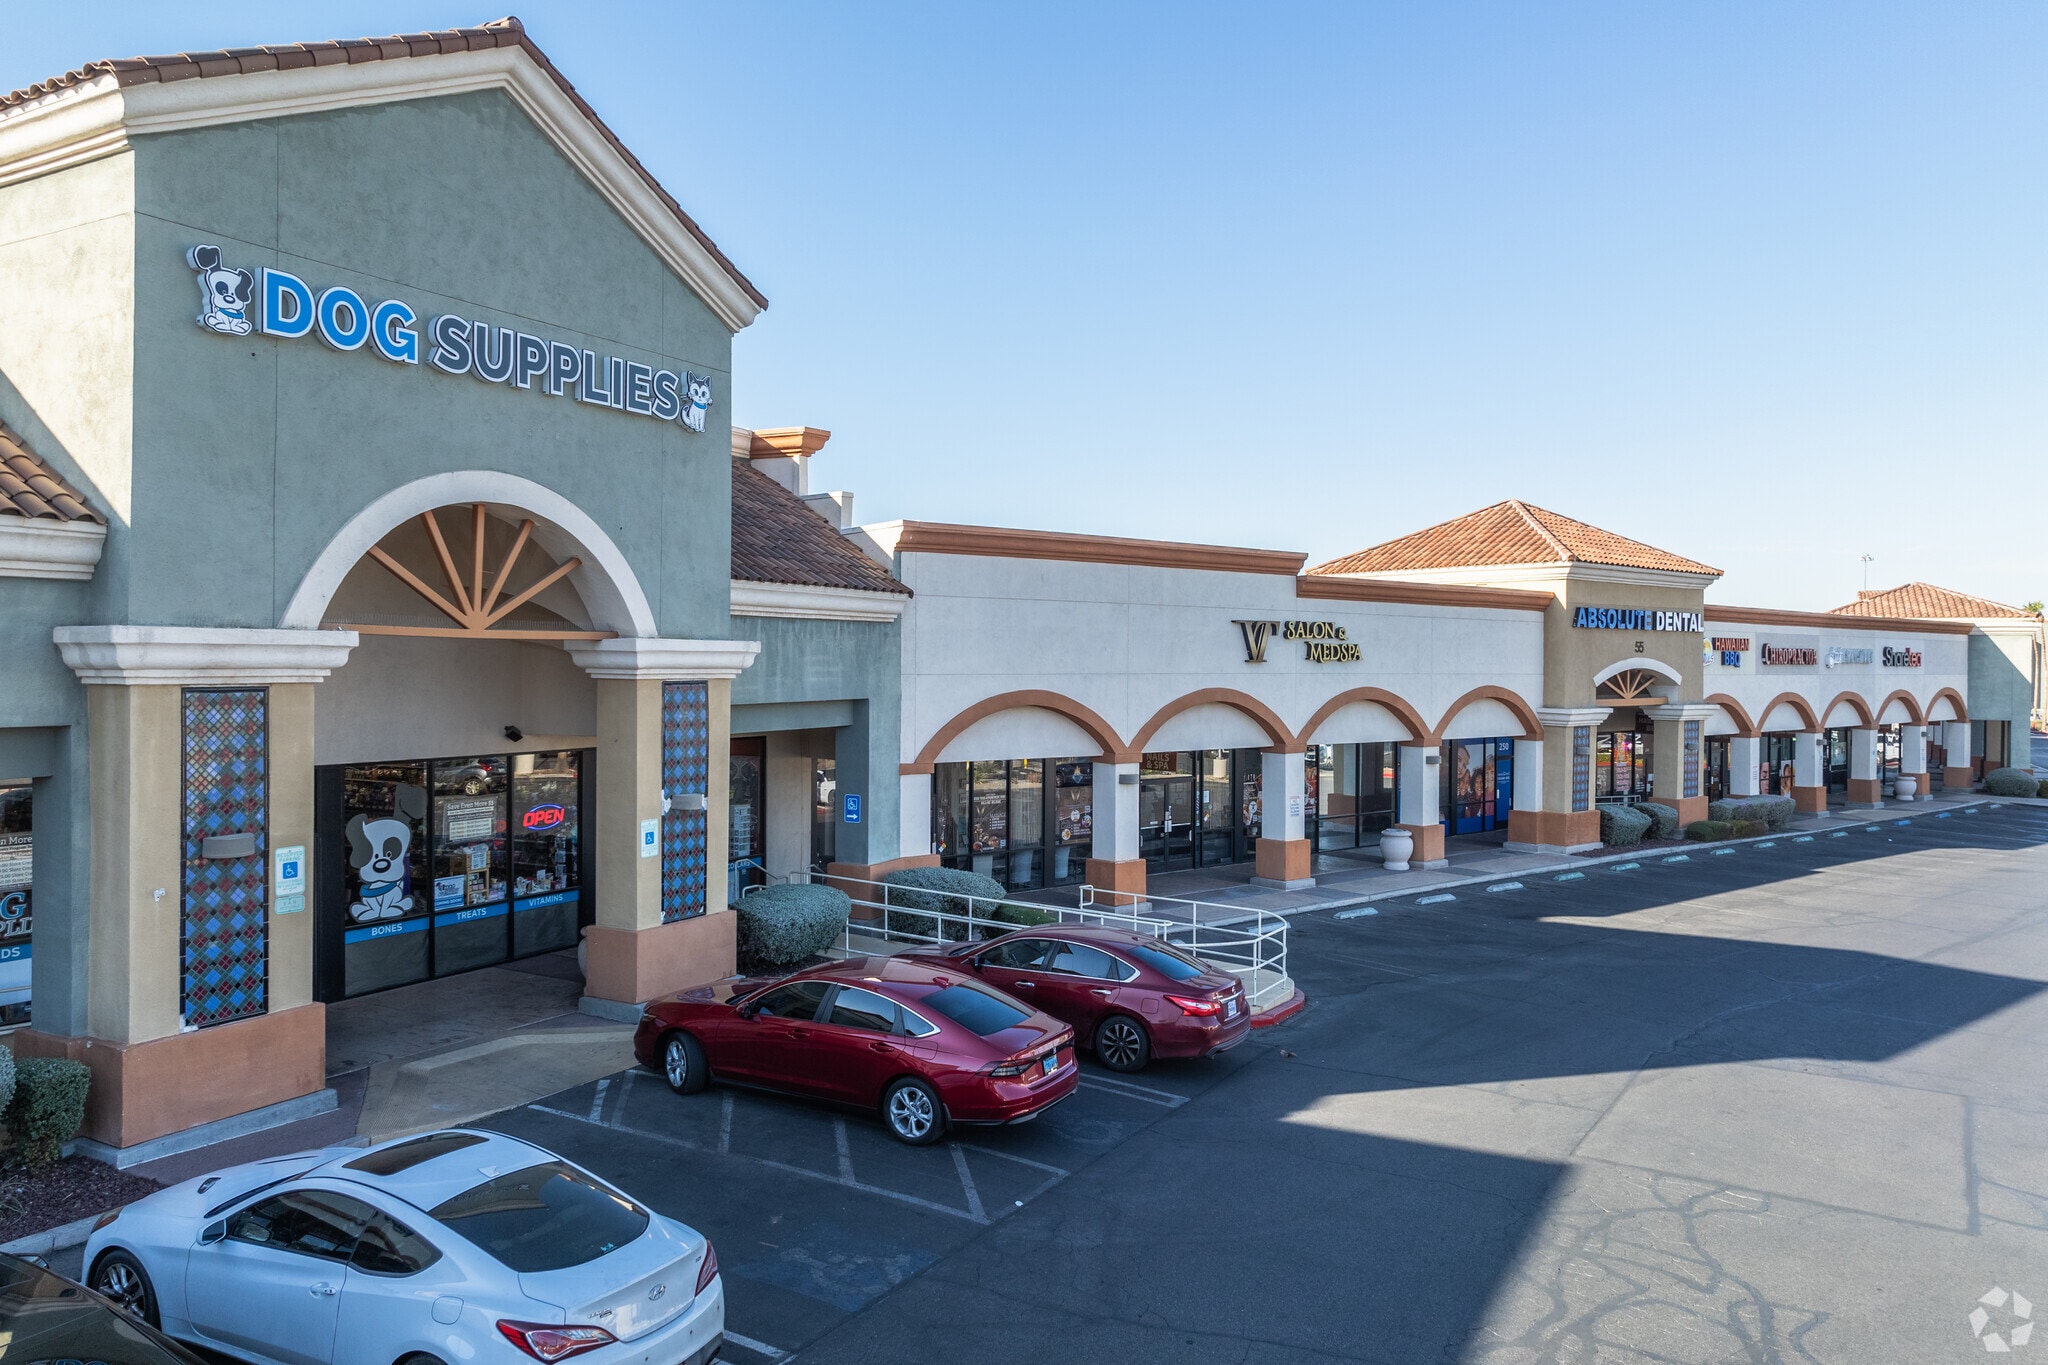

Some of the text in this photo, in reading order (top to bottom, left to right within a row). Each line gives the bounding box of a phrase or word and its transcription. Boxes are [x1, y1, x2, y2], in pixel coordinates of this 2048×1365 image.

[257, 266, 680, 421] DOG SUPPLIES
[1575, 607, 1705, 633] ABSOLUTE DENTAL
[1285, 620, 1336, 640] SALON
[1337, 626, 1348, 640] &
[1634, 641, 1645, 653] 55
[1714, 637, 1750, 651] HAWAIIAN
[1305, 641, 1363, 663] MEDSPA
[1763, 643, 1818, 665] CHIROPRACTOR
[1723, 651, 1741, 668] BBQ
[1498, 742, 1510, 751] 250
[1146, 753, 1170, 762] NAILS
[1146, 760, 1169, 770] & SPA
[523, 807, 565, 828] OPEN
[529, 893, 564, 907] VITAMINS
[456, 907, 488, 920] TREATS
[371, 923, 403, 936] BONES
